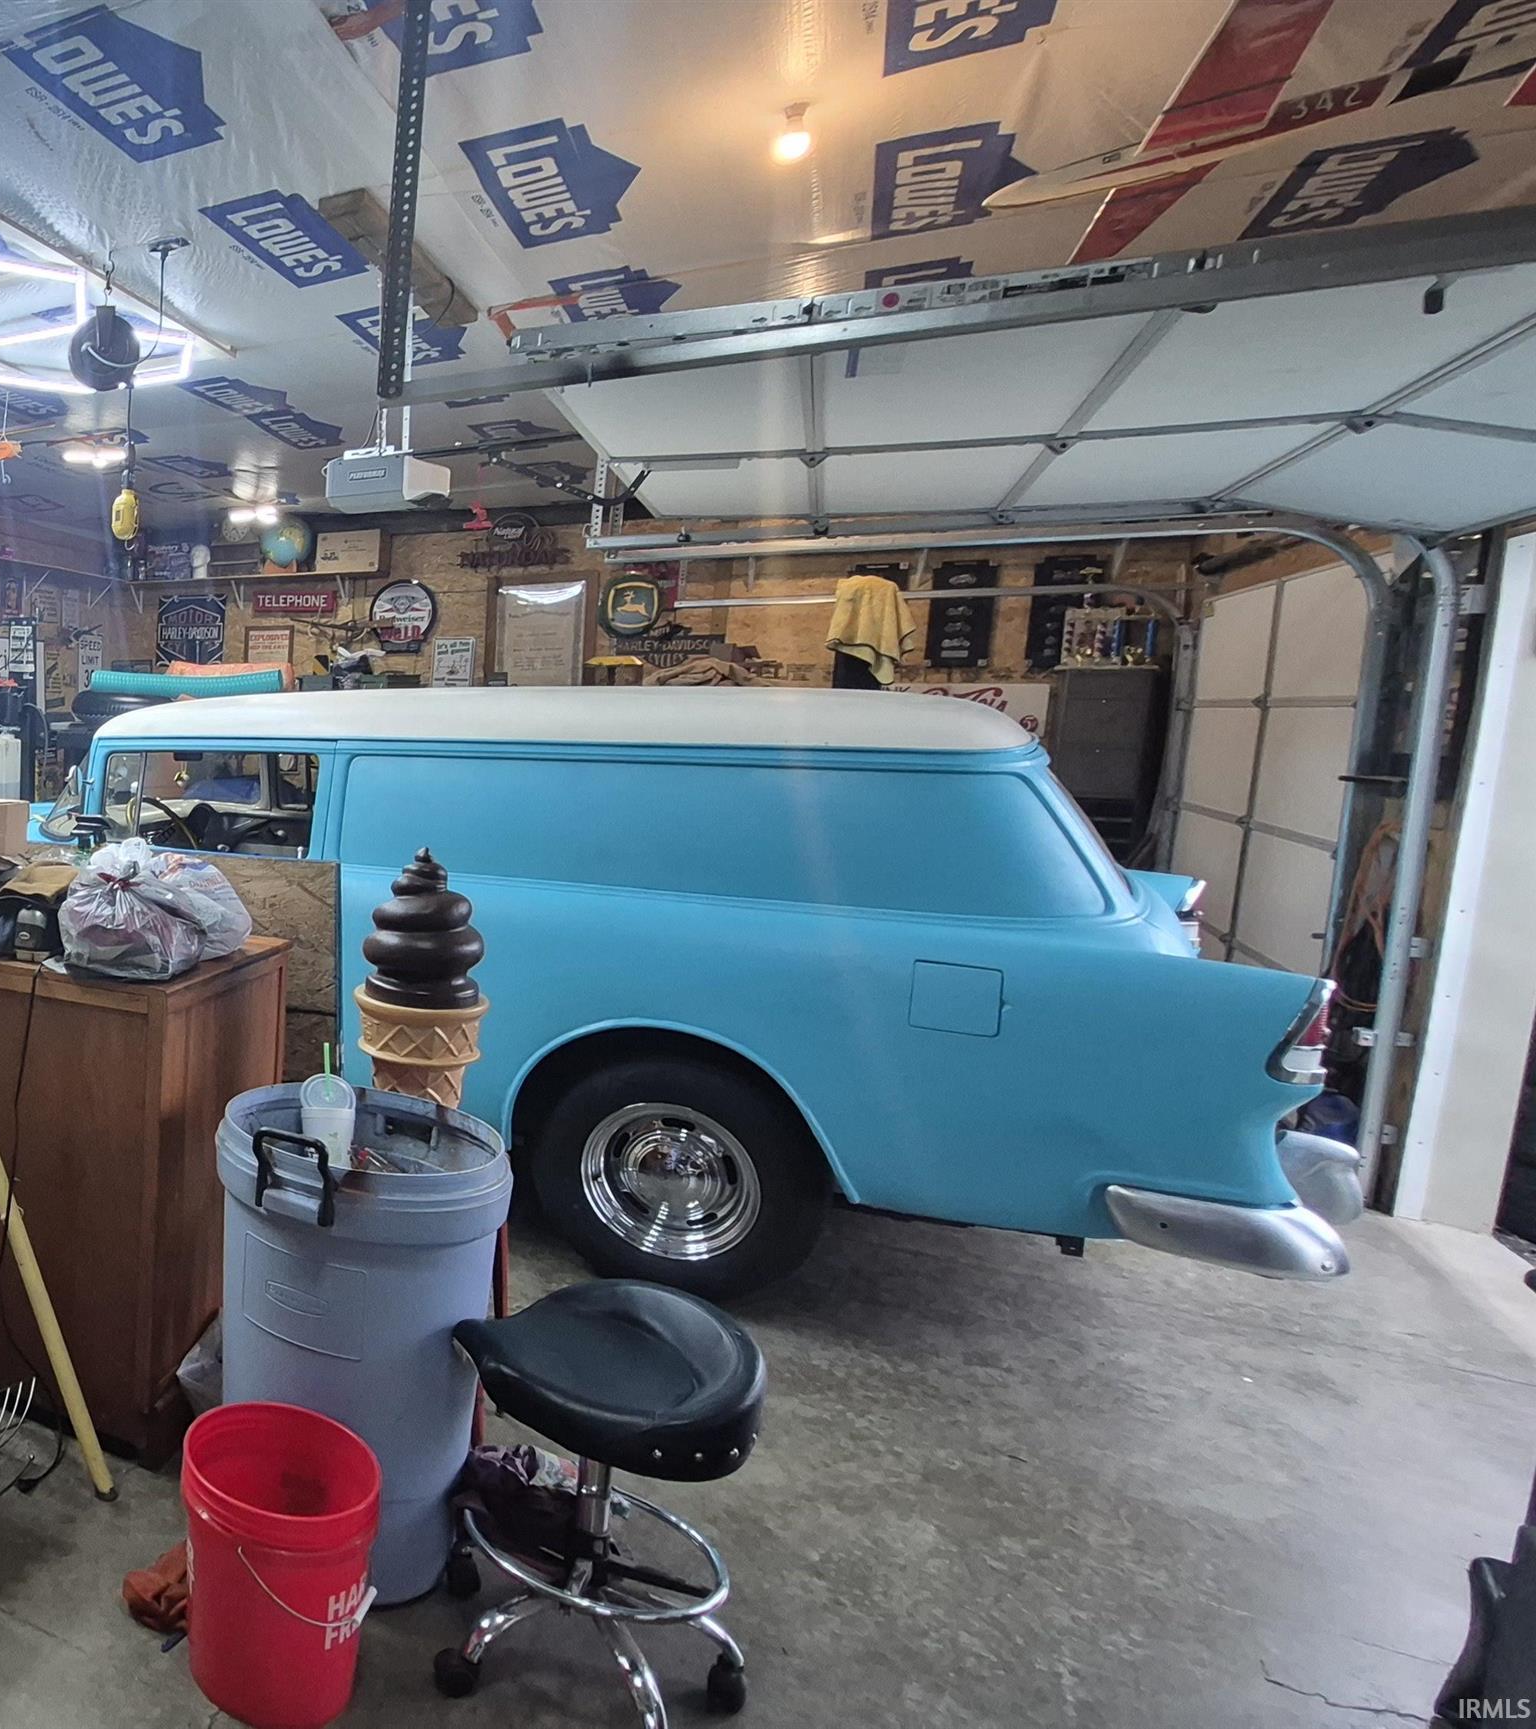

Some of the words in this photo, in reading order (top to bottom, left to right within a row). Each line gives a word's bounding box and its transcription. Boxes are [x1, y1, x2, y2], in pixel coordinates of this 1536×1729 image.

[1291, 86, 1362, 120] 342
[257, 594, 328, 608] TELEPHONE
[80, 640, 101, 651] SPEED
[81, 656, 99, 665] LIMIT
